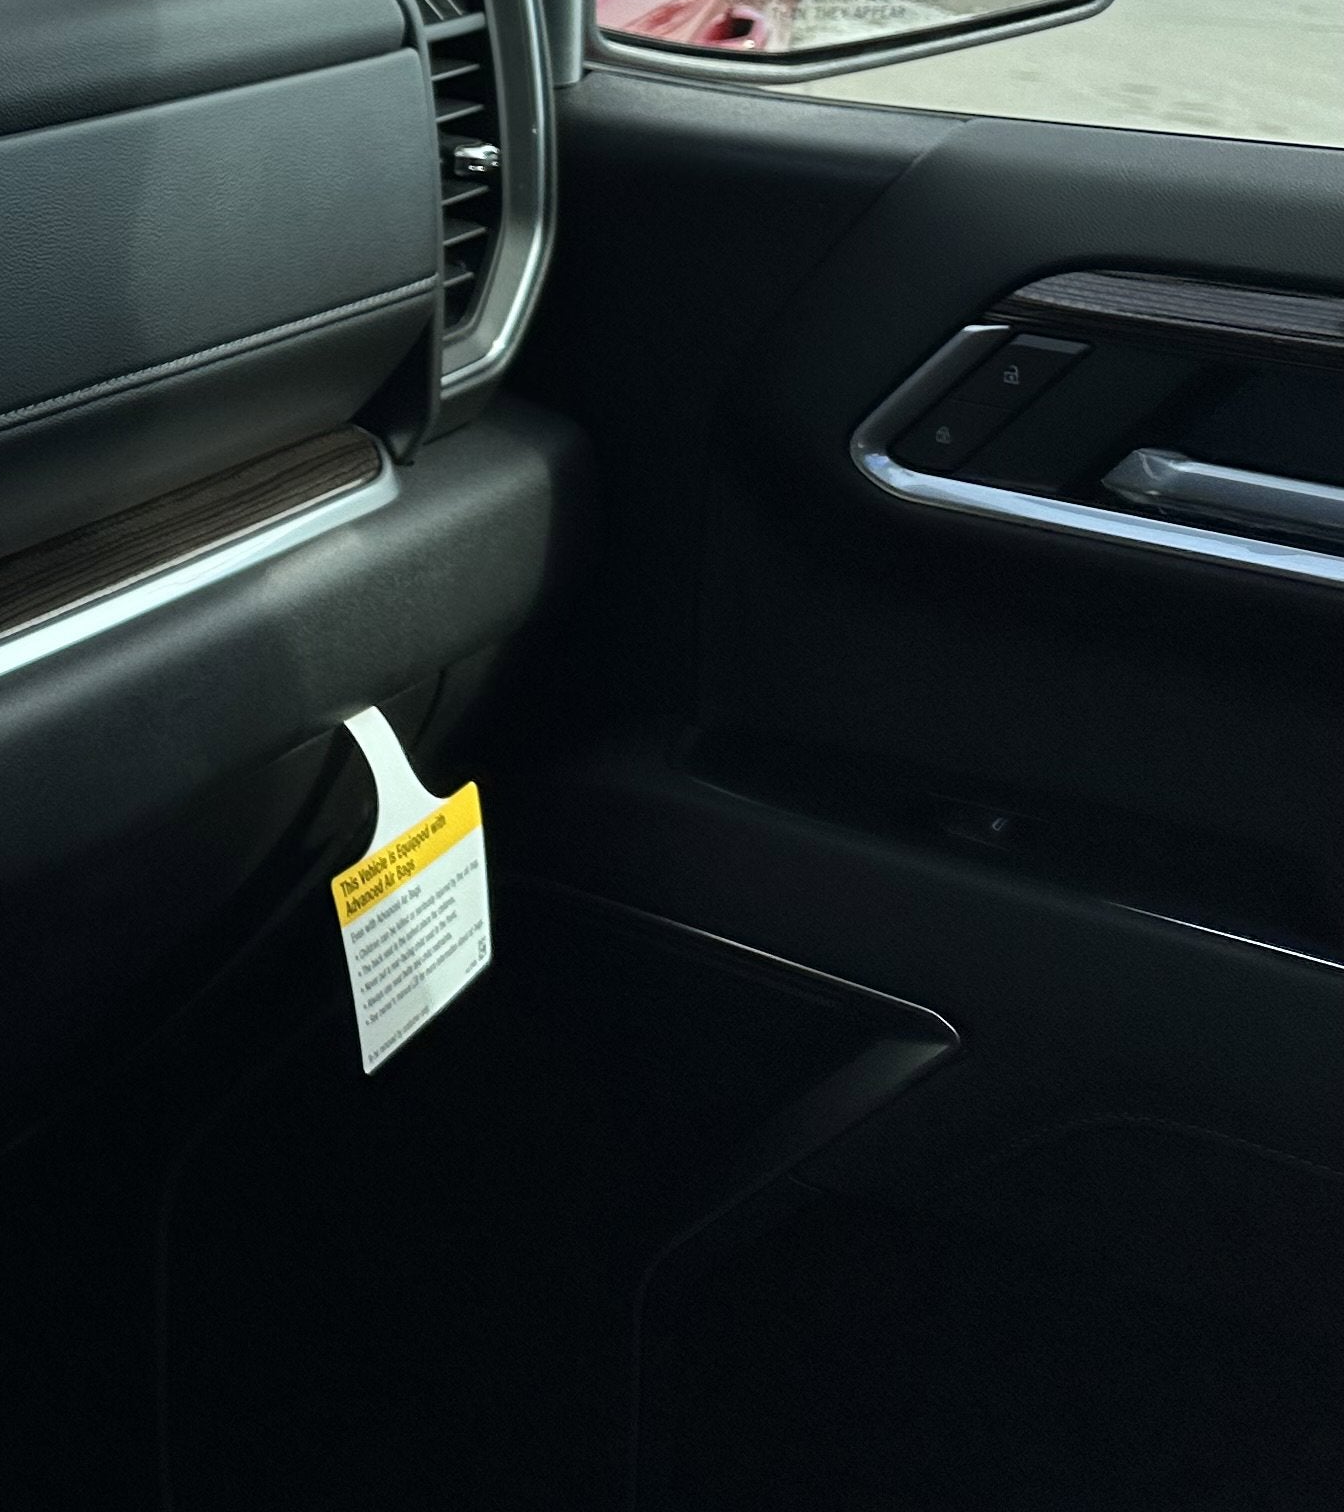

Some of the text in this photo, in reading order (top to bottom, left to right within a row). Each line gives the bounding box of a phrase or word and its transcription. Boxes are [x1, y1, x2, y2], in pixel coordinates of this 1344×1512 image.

[340, 812, 447, 897] This Vehicle is Equipped with
[345, 859, 416, 918] Advanced Air Bags
